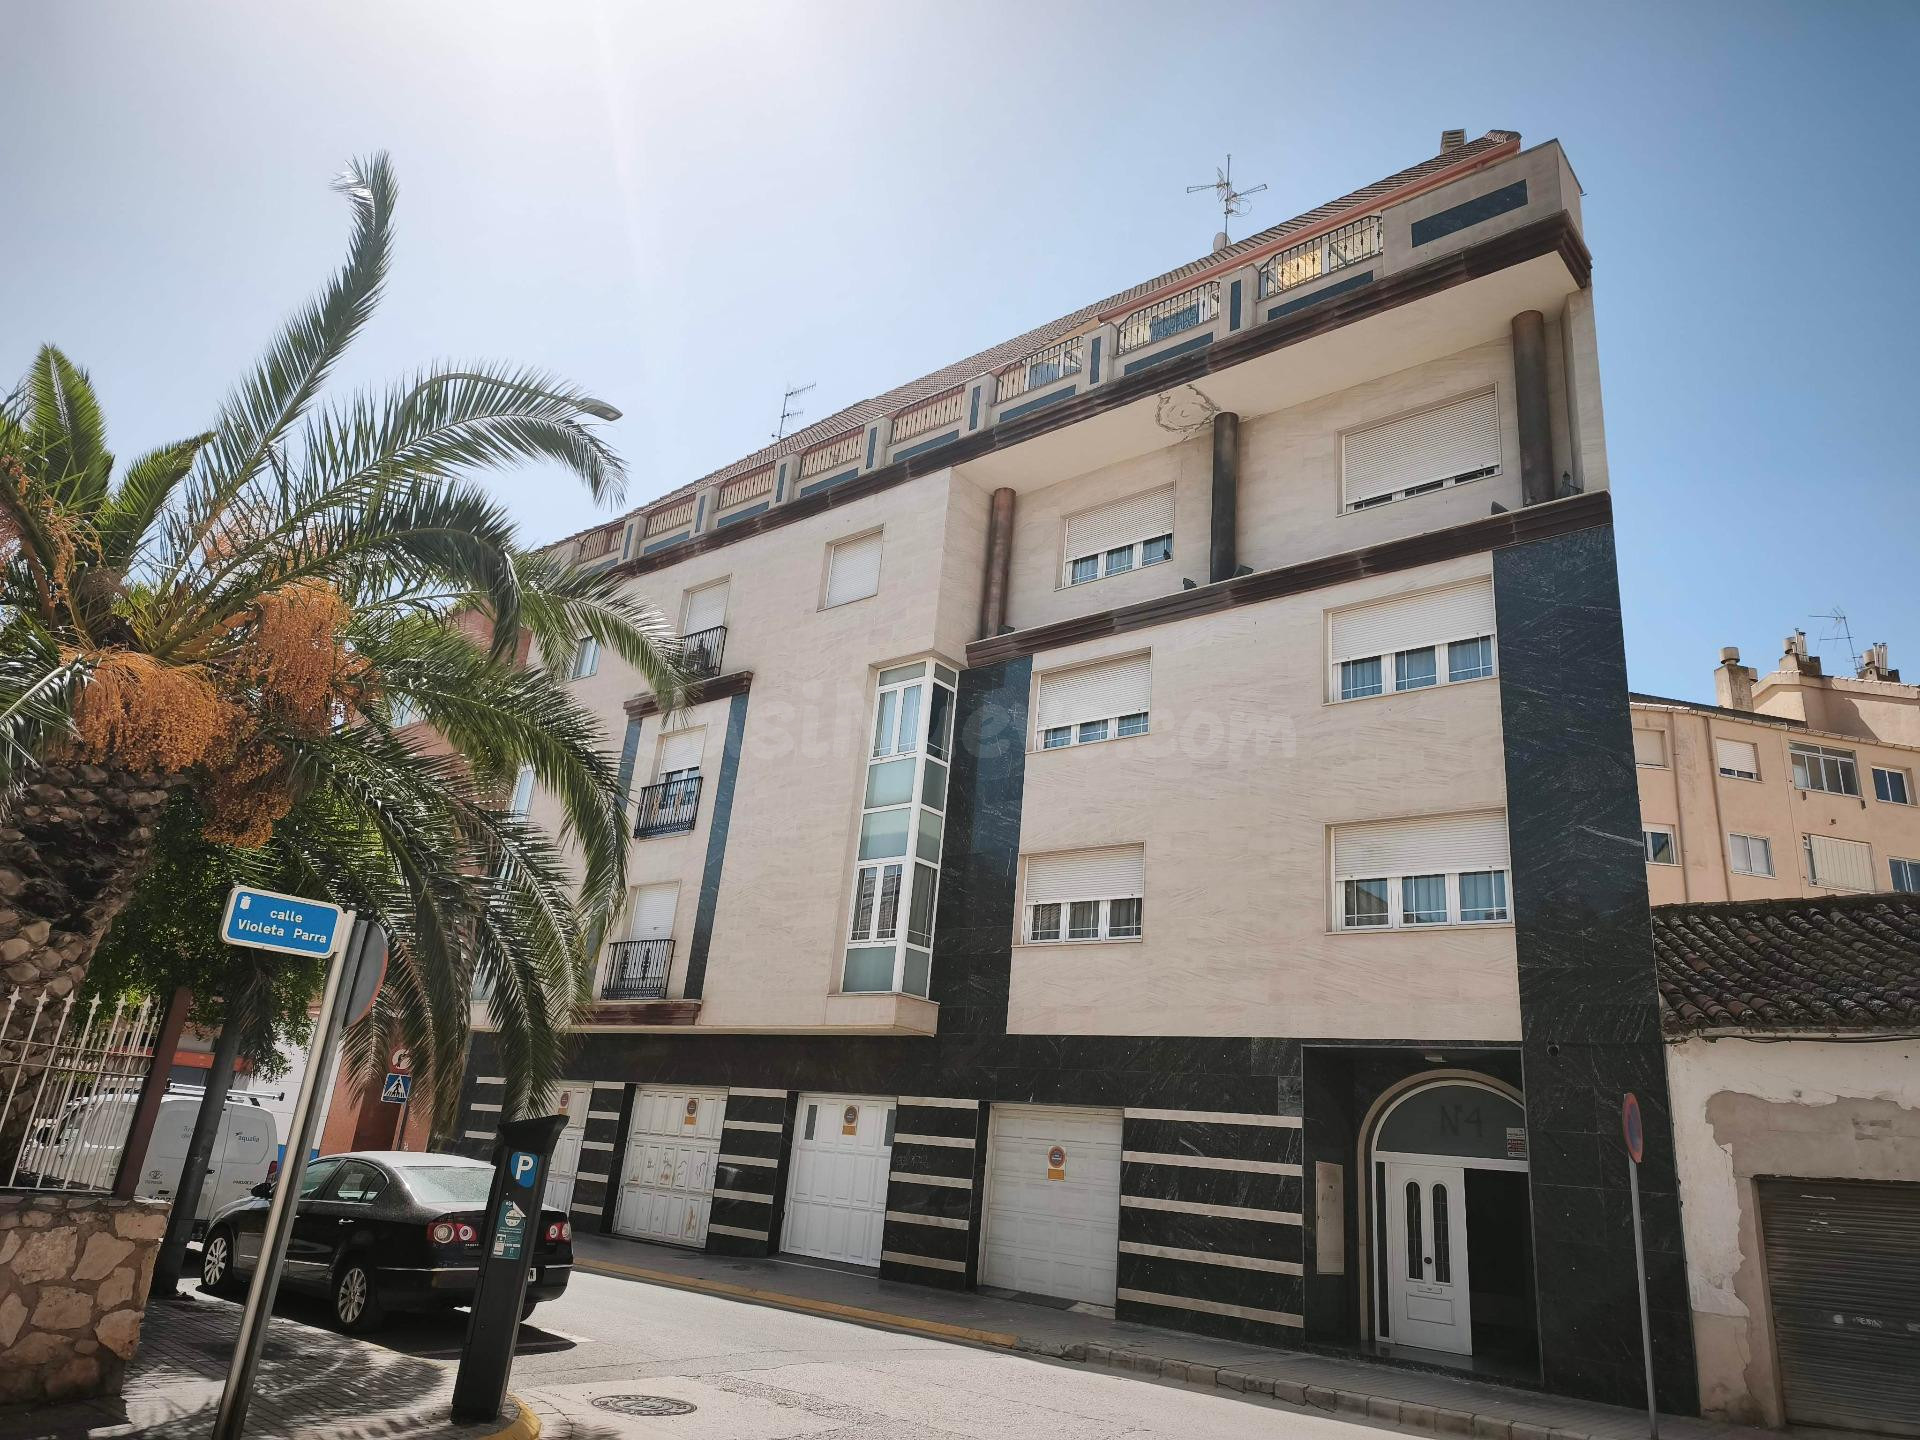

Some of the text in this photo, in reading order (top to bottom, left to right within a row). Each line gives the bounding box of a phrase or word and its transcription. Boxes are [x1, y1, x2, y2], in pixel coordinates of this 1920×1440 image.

[270, 909, 303, 923] calle
[238, 918, 328, 944] Violeta Parra
[515, 1155, 534, 1180] P
